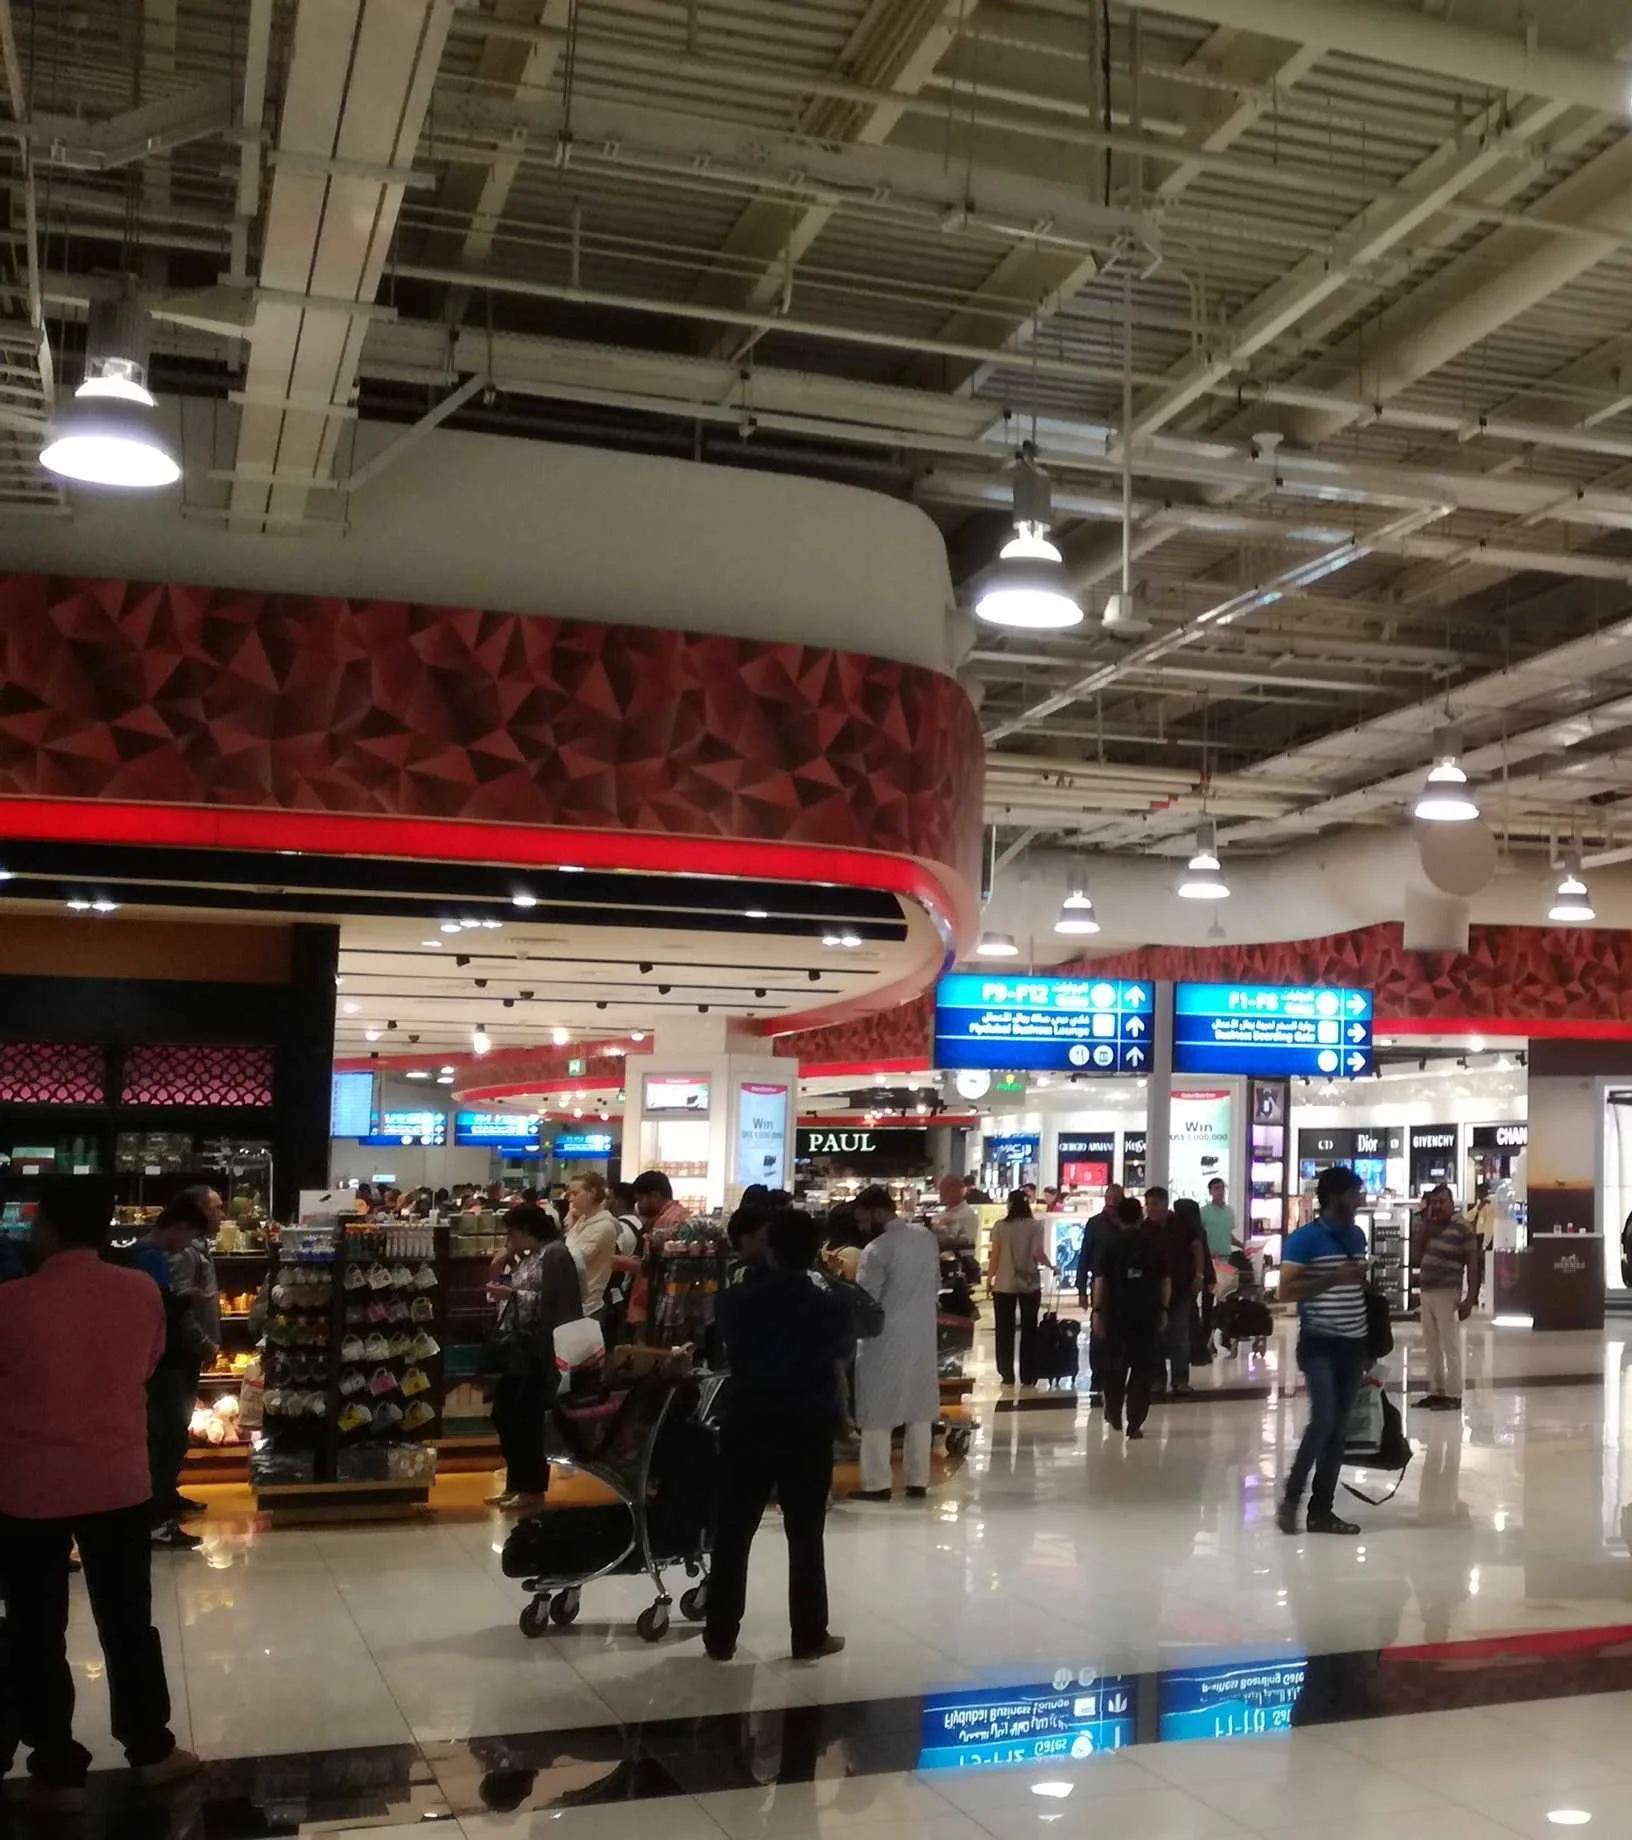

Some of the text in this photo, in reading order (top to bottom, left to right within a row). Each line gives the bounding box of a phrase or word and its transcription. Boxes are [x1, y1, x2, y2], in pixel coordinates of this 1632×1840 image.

[1185, 1121, 1213, 1132] Win
[808, 1133, 876, 1152] PAUL
[1358, 1134, 1378, 1153] Dior
[1413, 1134, 1455, 1148] GIVENCHY
